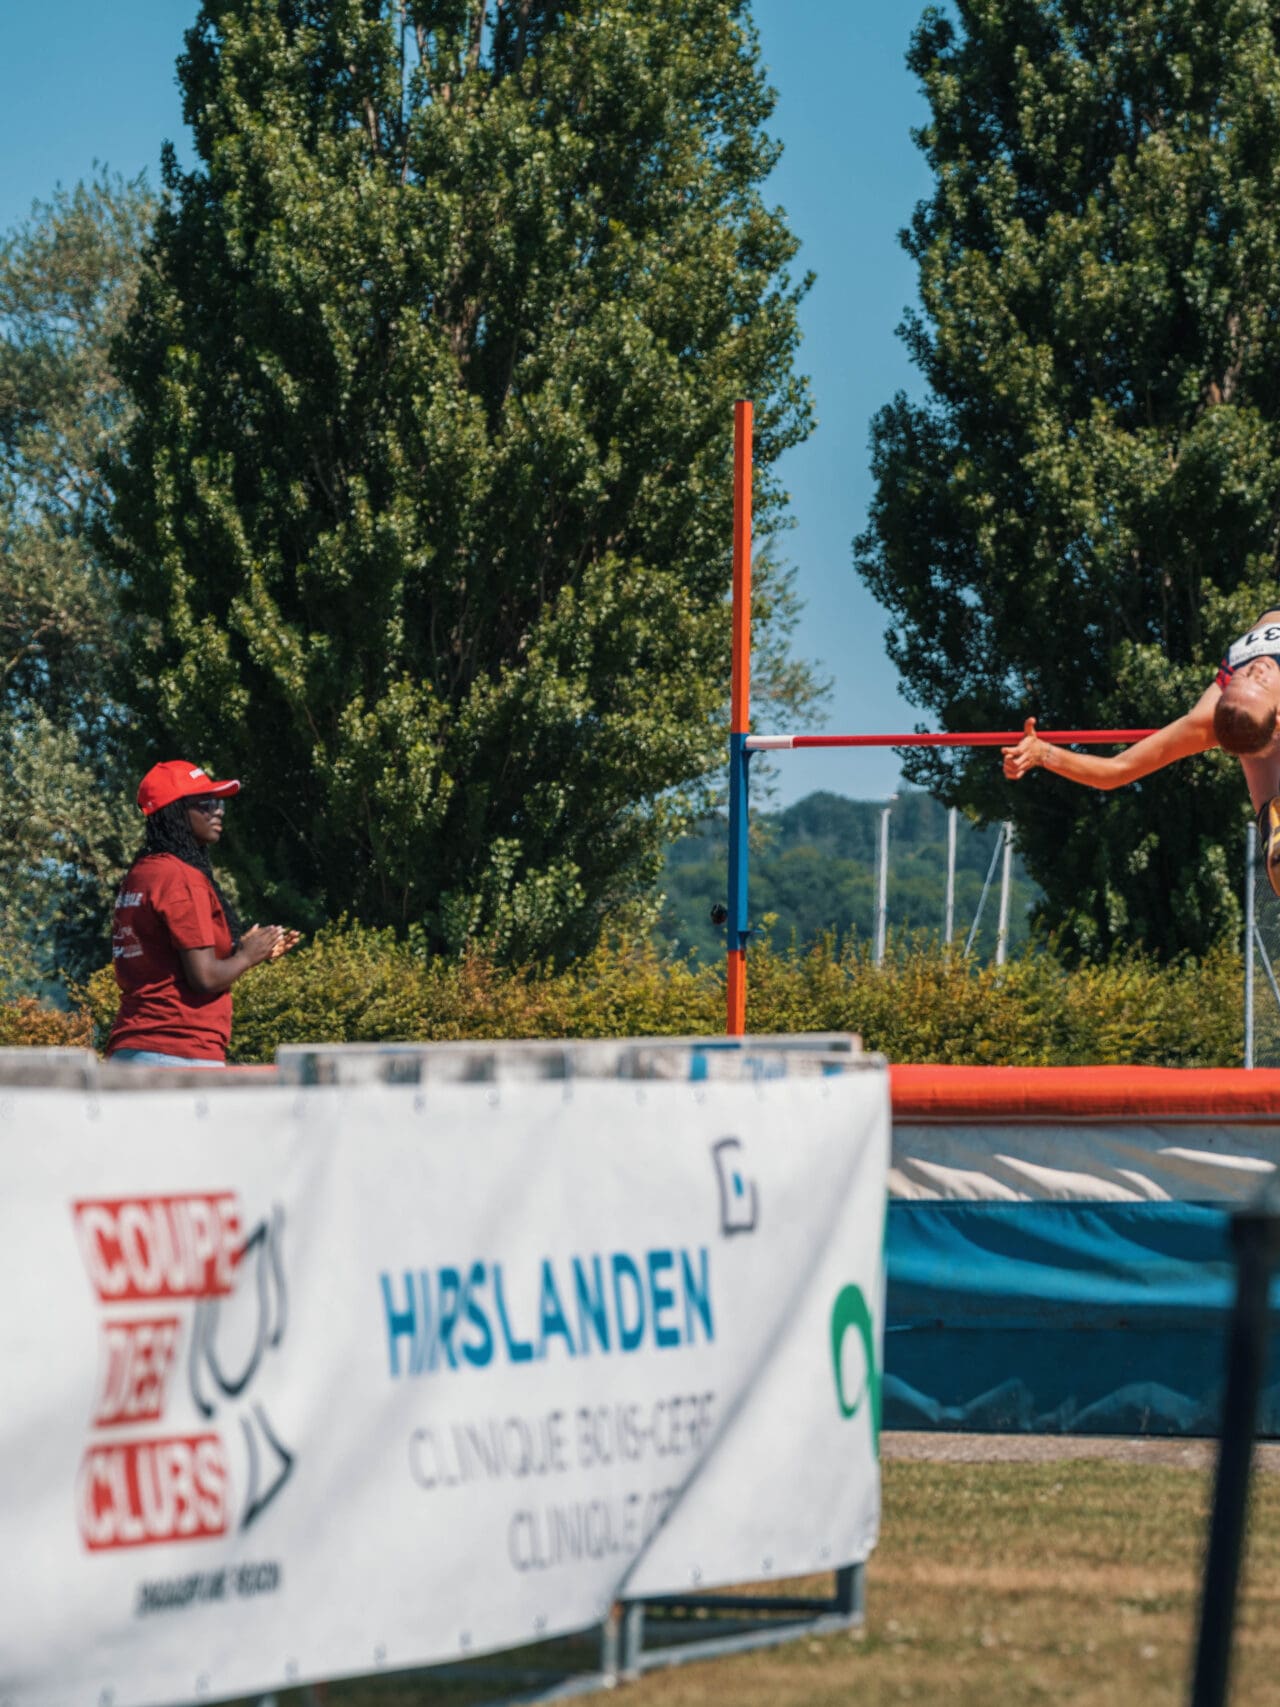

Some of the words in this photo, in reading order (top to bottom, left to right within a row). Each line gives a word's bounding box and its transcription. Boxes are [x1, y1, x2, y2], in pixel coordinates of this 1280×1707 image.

[80, 1198, 240, 1295] COUPE
[380, 1246, 715, 1380] HIRSLANDEN
[96, 1323, 179, 1417] DES
[78, 1440, 229, 1545] CLUBS
[408, 1406, 568, 1490] CLINIQUE
[506, 1492, 639, 1574] CLINIQUE
